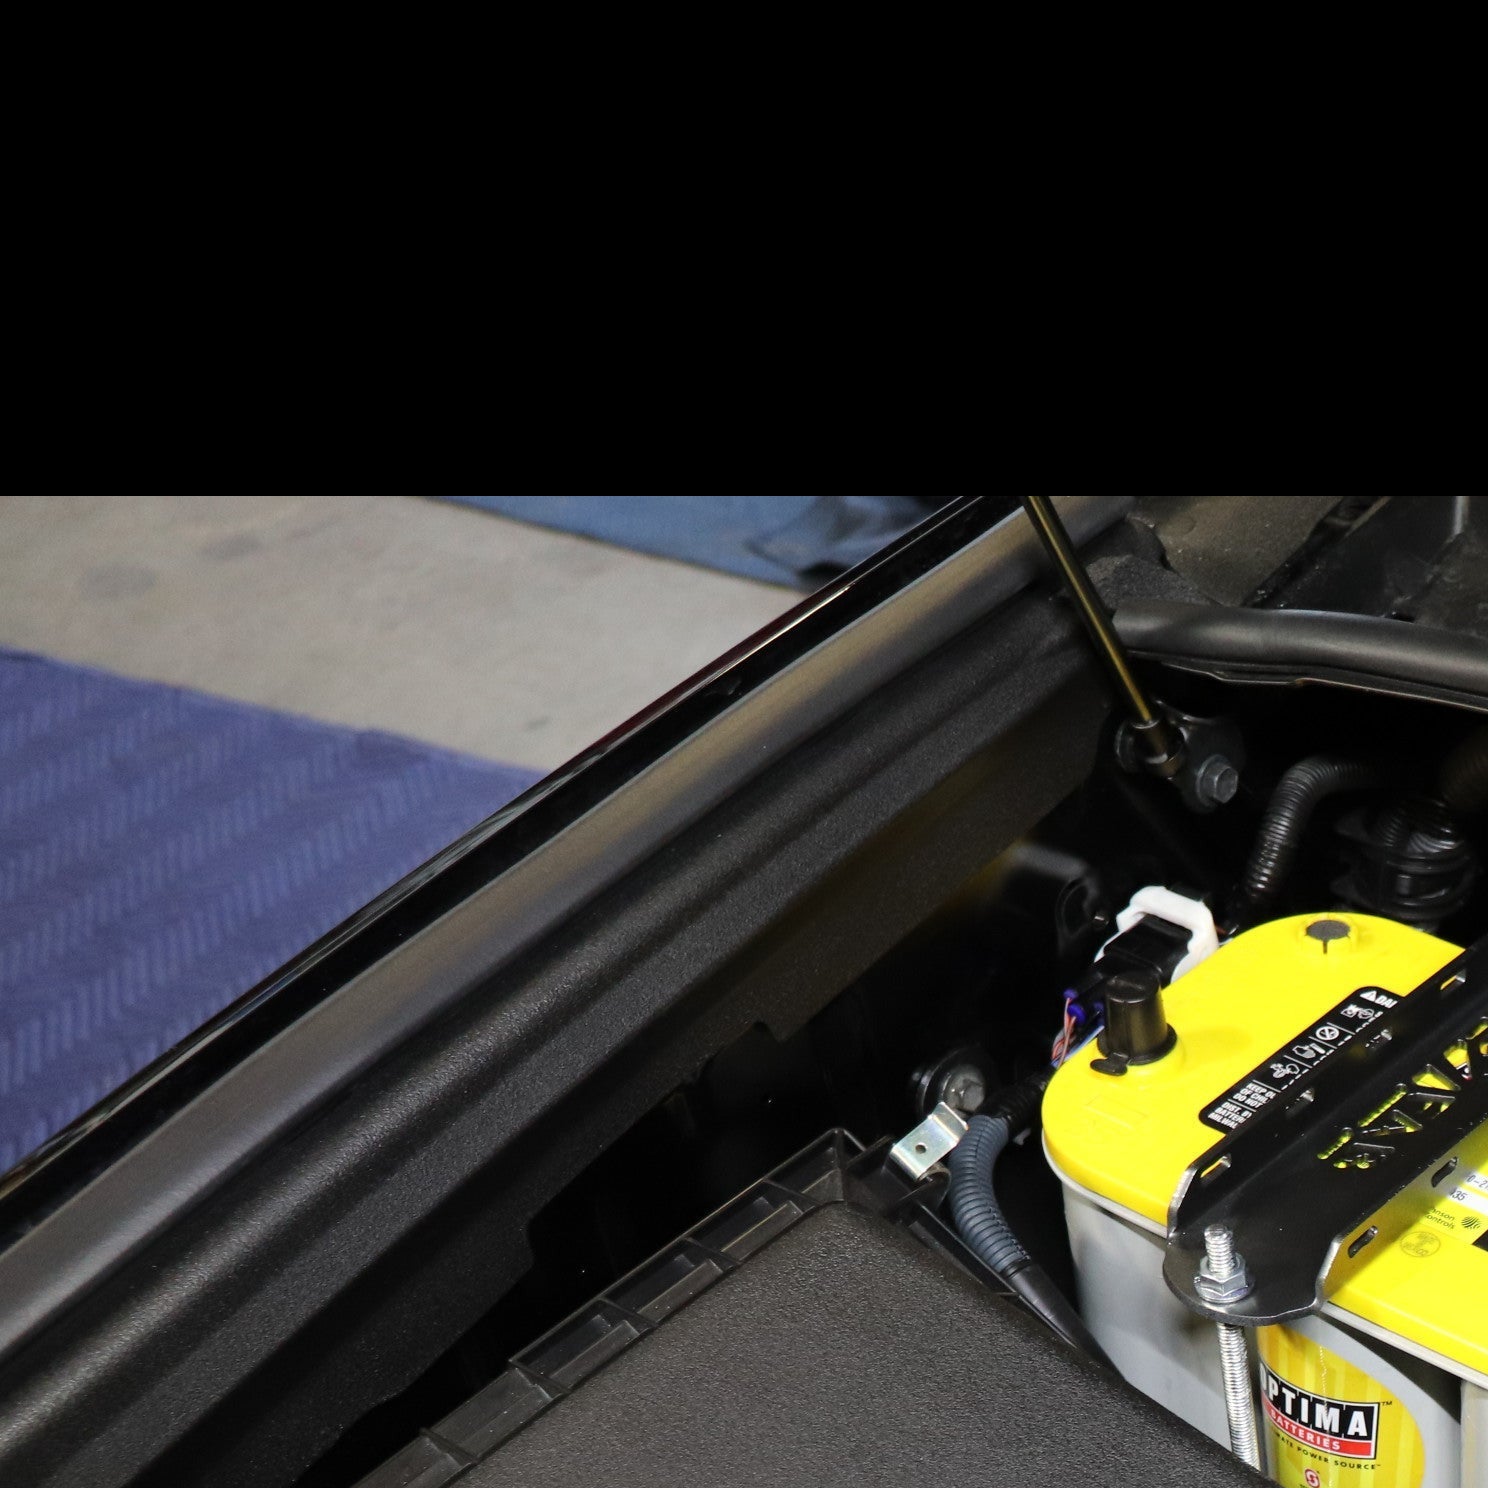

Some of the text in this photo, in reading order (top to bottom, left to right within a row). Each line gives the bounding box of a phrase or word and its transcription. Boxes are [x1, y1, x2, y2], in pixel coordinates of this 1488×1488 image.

[1239, 1088, 1253, 1097] OF
[1246, 1083, 1268, 1094] KEEP
[1232, 1093, 1264, 1109] DO NOT
[1259, 1362, 1368, 1437] OPTIMA
[1270, 1408, 1341, 1451] BATTERIES
[1297, 1447, 1329, 1463] POWER
